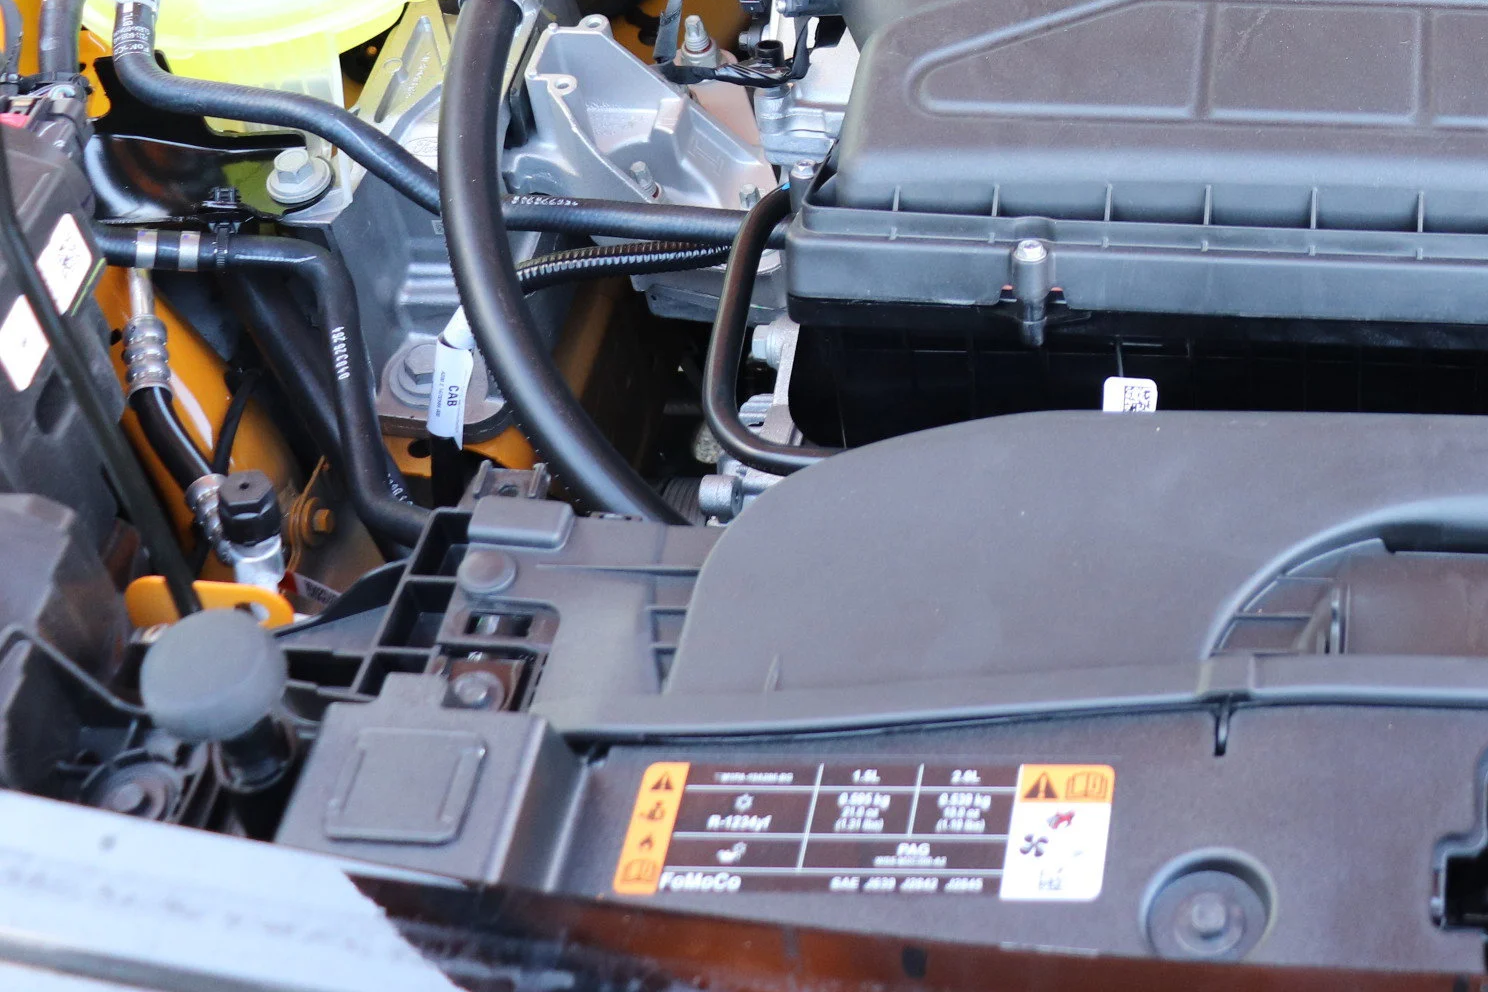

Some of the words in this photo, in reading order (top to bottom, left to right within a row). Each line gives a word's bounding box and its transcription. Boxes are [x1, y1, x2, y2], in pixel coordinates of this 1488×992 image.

[446, 385, 460, 407] CAB
[706, 814, 773, 833] R-1234yf
[896, 842, 931, 856] PAG
[658, 871, 742, 892] FoMoCo
[829, 875, 861, 892] SAE
